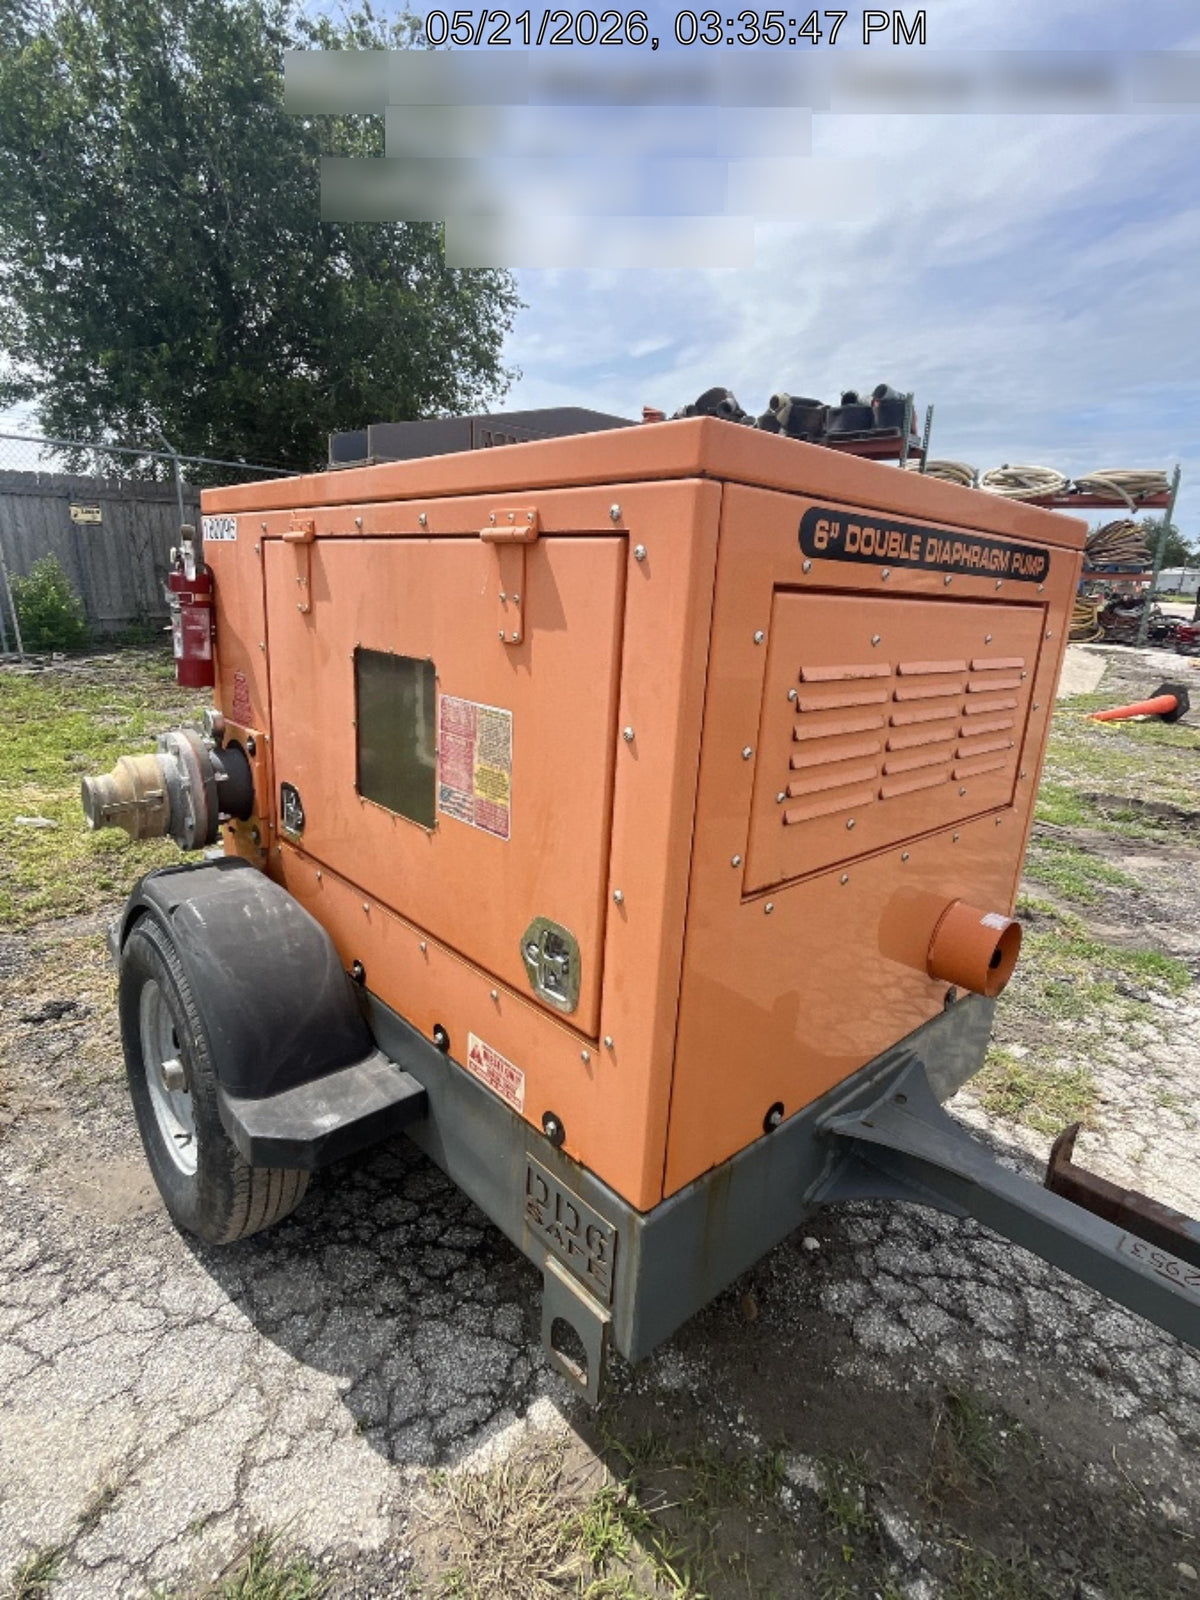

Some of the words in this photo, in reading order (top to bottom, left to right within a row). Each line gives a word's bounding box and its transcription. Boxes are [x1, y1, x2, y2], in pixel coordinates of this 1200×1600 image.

[844, 525, 922, 560] DOUBLE
[925, 538, 1010, 571] DIAPHRAGM
[1011, 552, 1045, 576] PUMP
